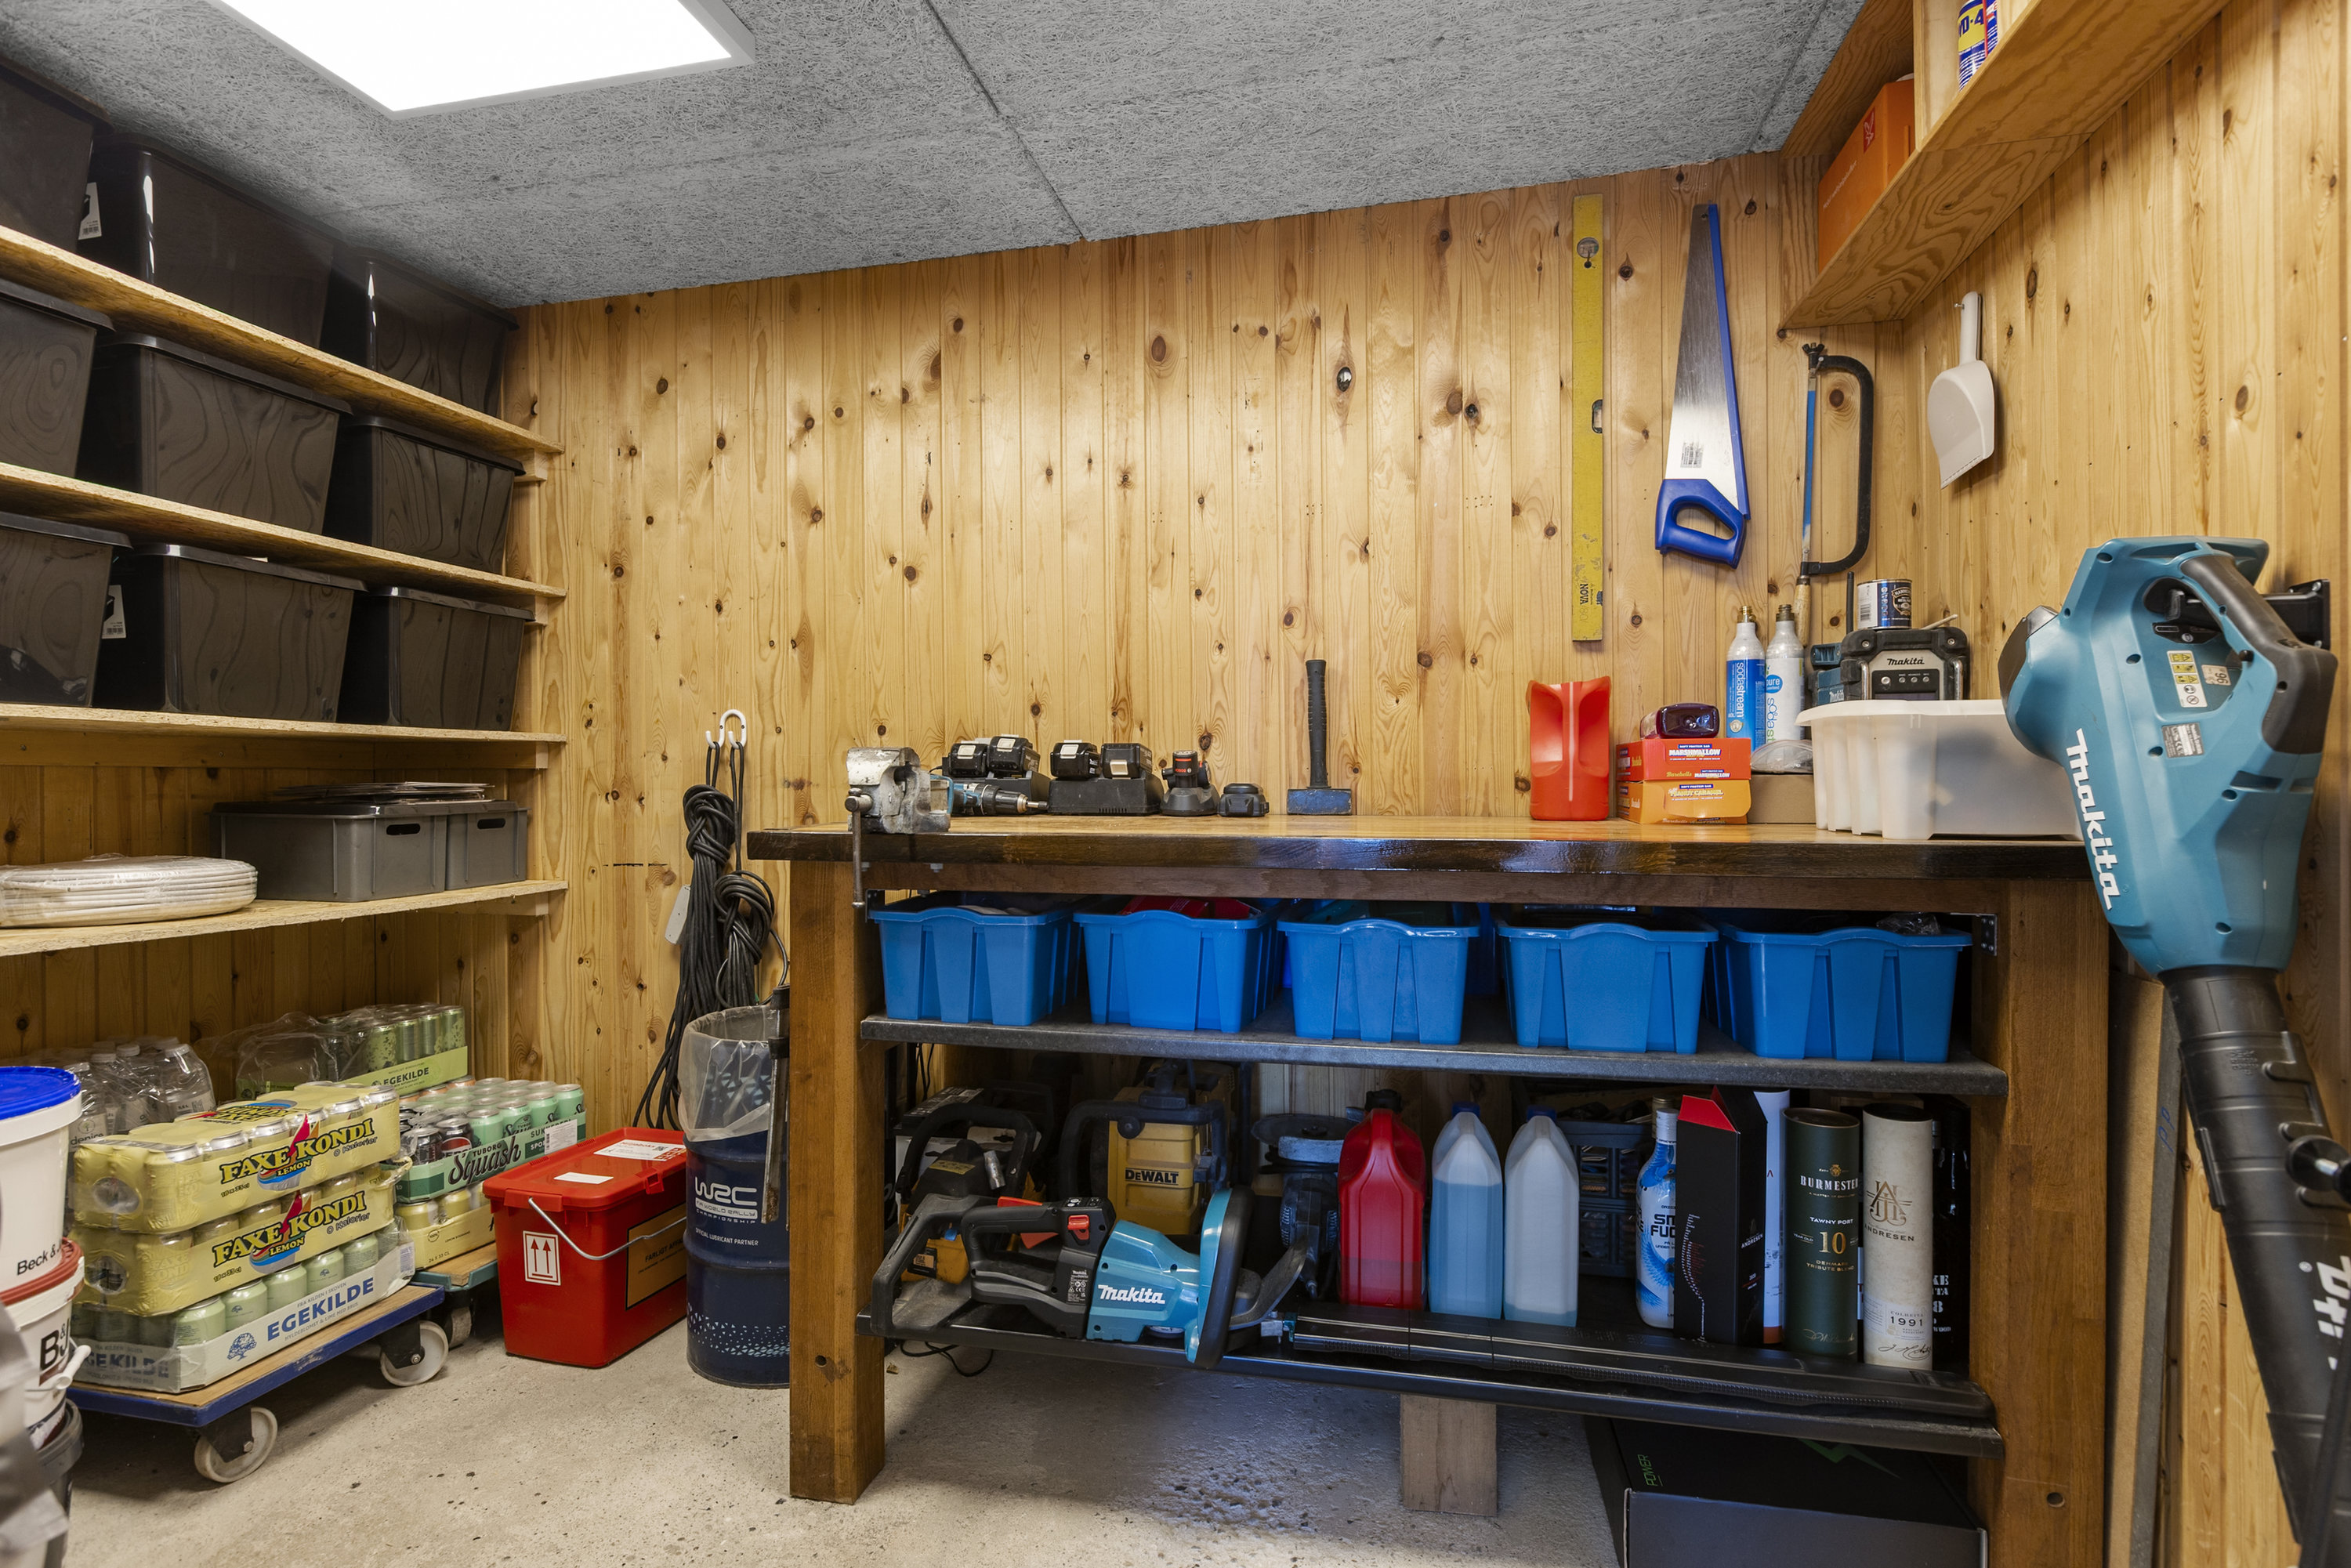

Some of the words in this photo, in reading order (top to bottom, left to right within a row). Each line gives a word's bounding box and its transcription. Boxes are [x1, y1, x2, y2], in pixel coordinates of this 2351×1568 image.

[1579, 583, 1588, 605] NOVA
[1737, 662, 1746, 718] sodastream
[1767, 697, 1777, 742] sodast
[219, 1146, 292, 1184] FAXE
[295, 1118, 375, 1159] KONDI
[342, 1136, 378, 1154] Kalorier
[473, 1142, 502, 1157] TUBORG
[276, 1159, 313, 1177] LEMON
[448, 1135, 522, 1184] Squash
[694, 1176, 758, 1206] WRC
[696, 1208, 756, 1224] CHAMPIONSHIP
[705, 1203, 726, 1214] WORLD
[212, 1221, 284, 1268] FAXE
[288, 1190, 368, 1238] KONDI
[335, 1212, 371, 1230] Kalorier
[1809, 1216, 1836, 1225] TAWNY
[695, 1227, 709, 1239] OFFICIAL
[709, 1233, 734, 1244] LUBRICANT
[1741, 1233, 1763, 1249] ANDRESEN
[1819, 1231, 1847, 1255] 10
[269, 1237, 306, 1256] LEMON
[645, 1246, 668, 1262] FARLIGT
[16, 1250, 49, 1276] Beck
[1806, 1262, 1835, 1272] TRIBUTE
[307, 1291, 325, 1303] KILDEN
[328, 1282, 347, 1294] SKOVEN
[267, 1277, 375, 1342] EGEKILDE
[1890, 1316, 1922, 1327] 1991
[1637, 1454, 1658, 1487] POWER
